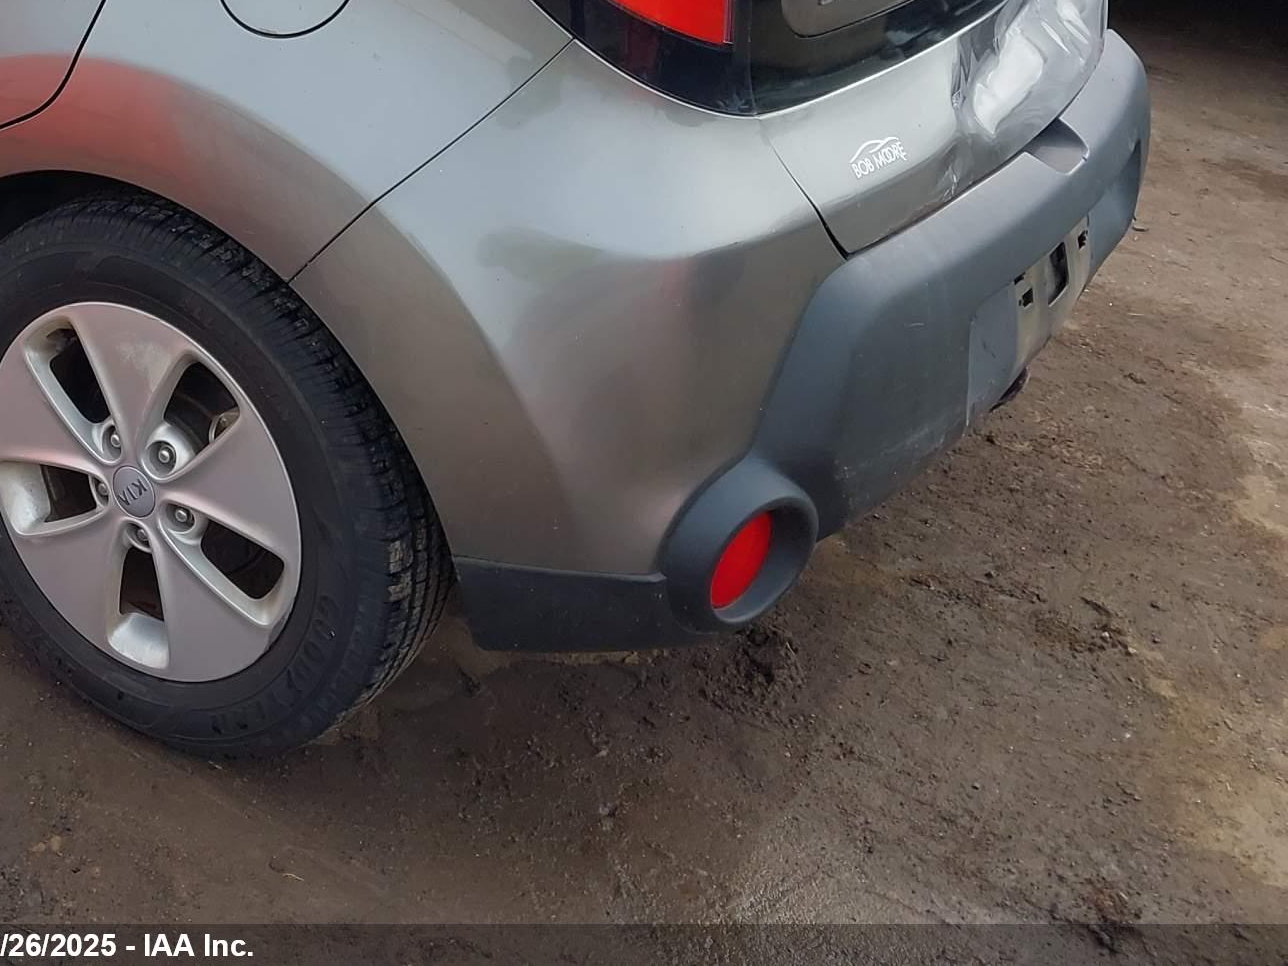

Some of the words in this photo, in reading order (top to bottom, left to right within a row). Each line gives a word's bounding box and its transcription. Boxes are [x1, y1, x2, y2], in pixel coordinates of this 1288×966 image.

[851, 157, 875, 179] BOB
[872, 141, 908, 170] MOORE
[117, 477, 148, 506] KIA
